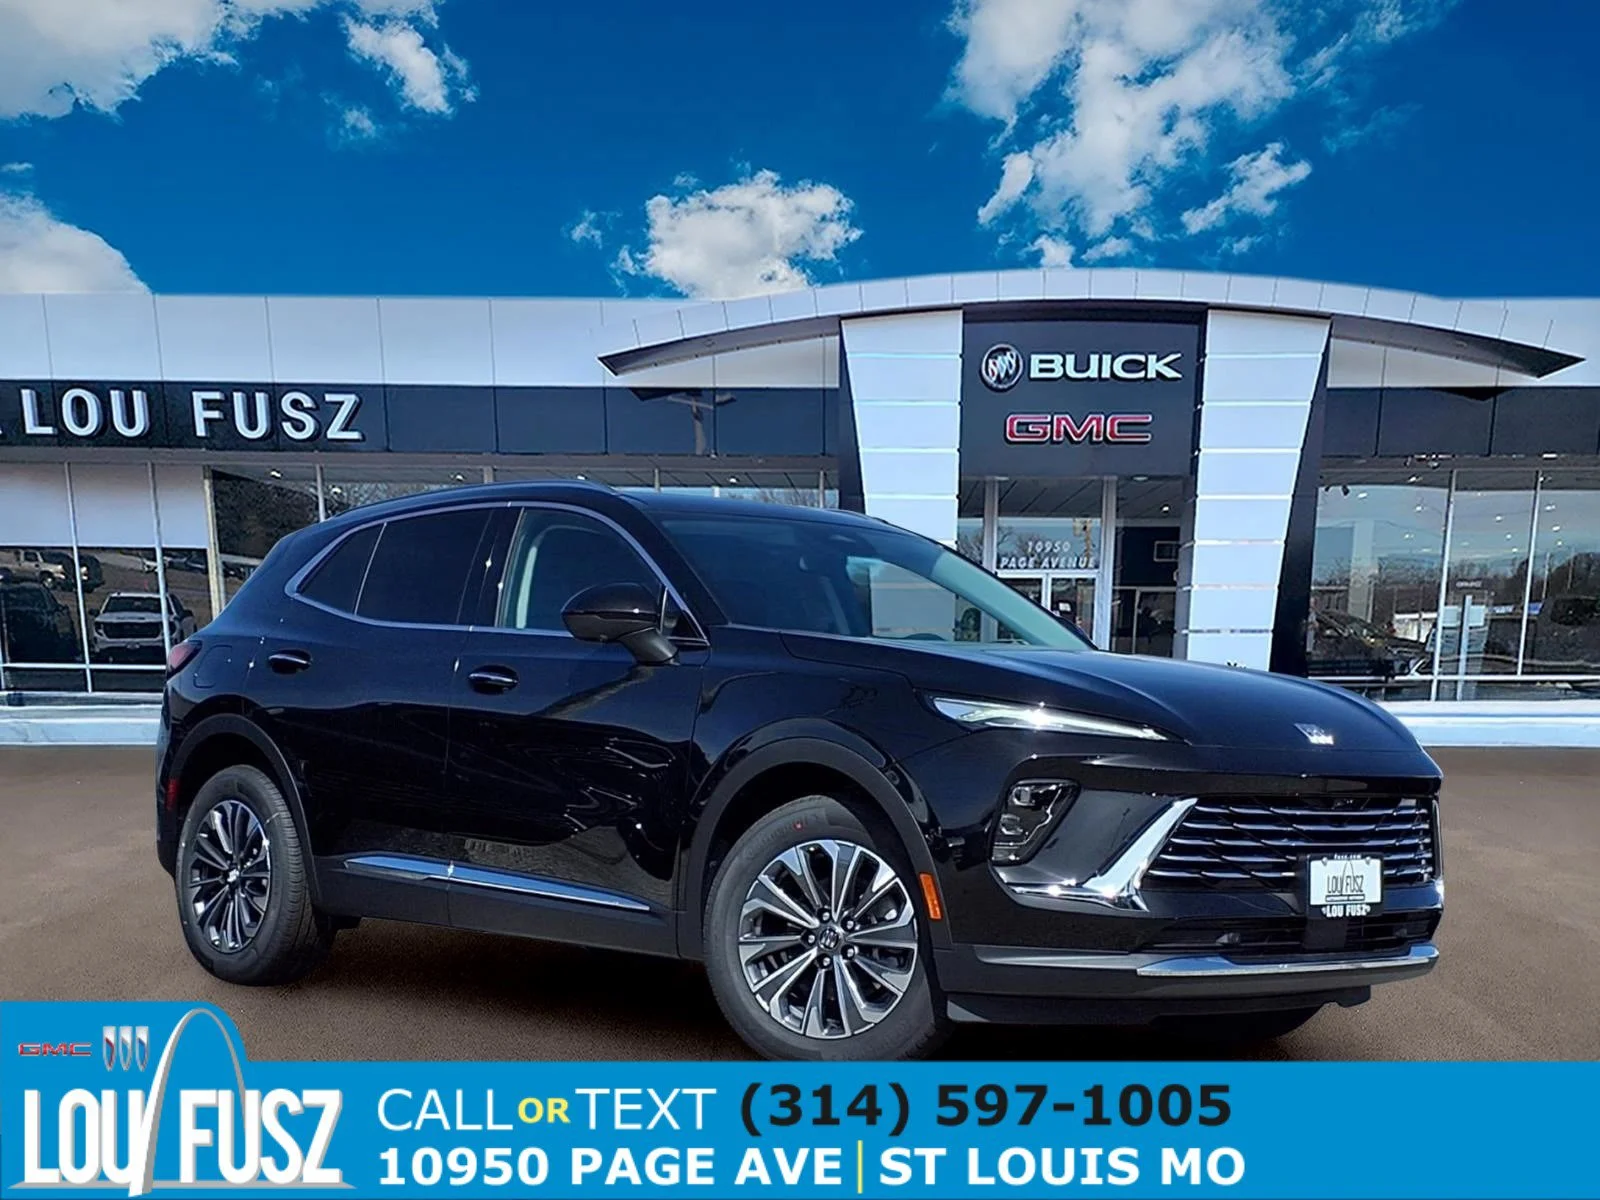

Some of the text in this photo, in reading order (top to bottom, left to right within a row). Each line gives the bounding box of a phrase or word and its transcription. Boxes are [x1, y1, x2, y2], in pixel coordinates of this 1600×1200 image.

[1029, 352, 1183, 380] BUICK
[20, 388, 364, 442] LOU FUSZ
[1005, 413, 1153, 444] GMC
[1027, 541, 1072, 553] 10950
[999, 556, 1096, 569] PAGE AVENUE
[1327, 875, 1364, 893] LOU FUSZ
[1326, 904, 1367, 917] LOU FUSZ
